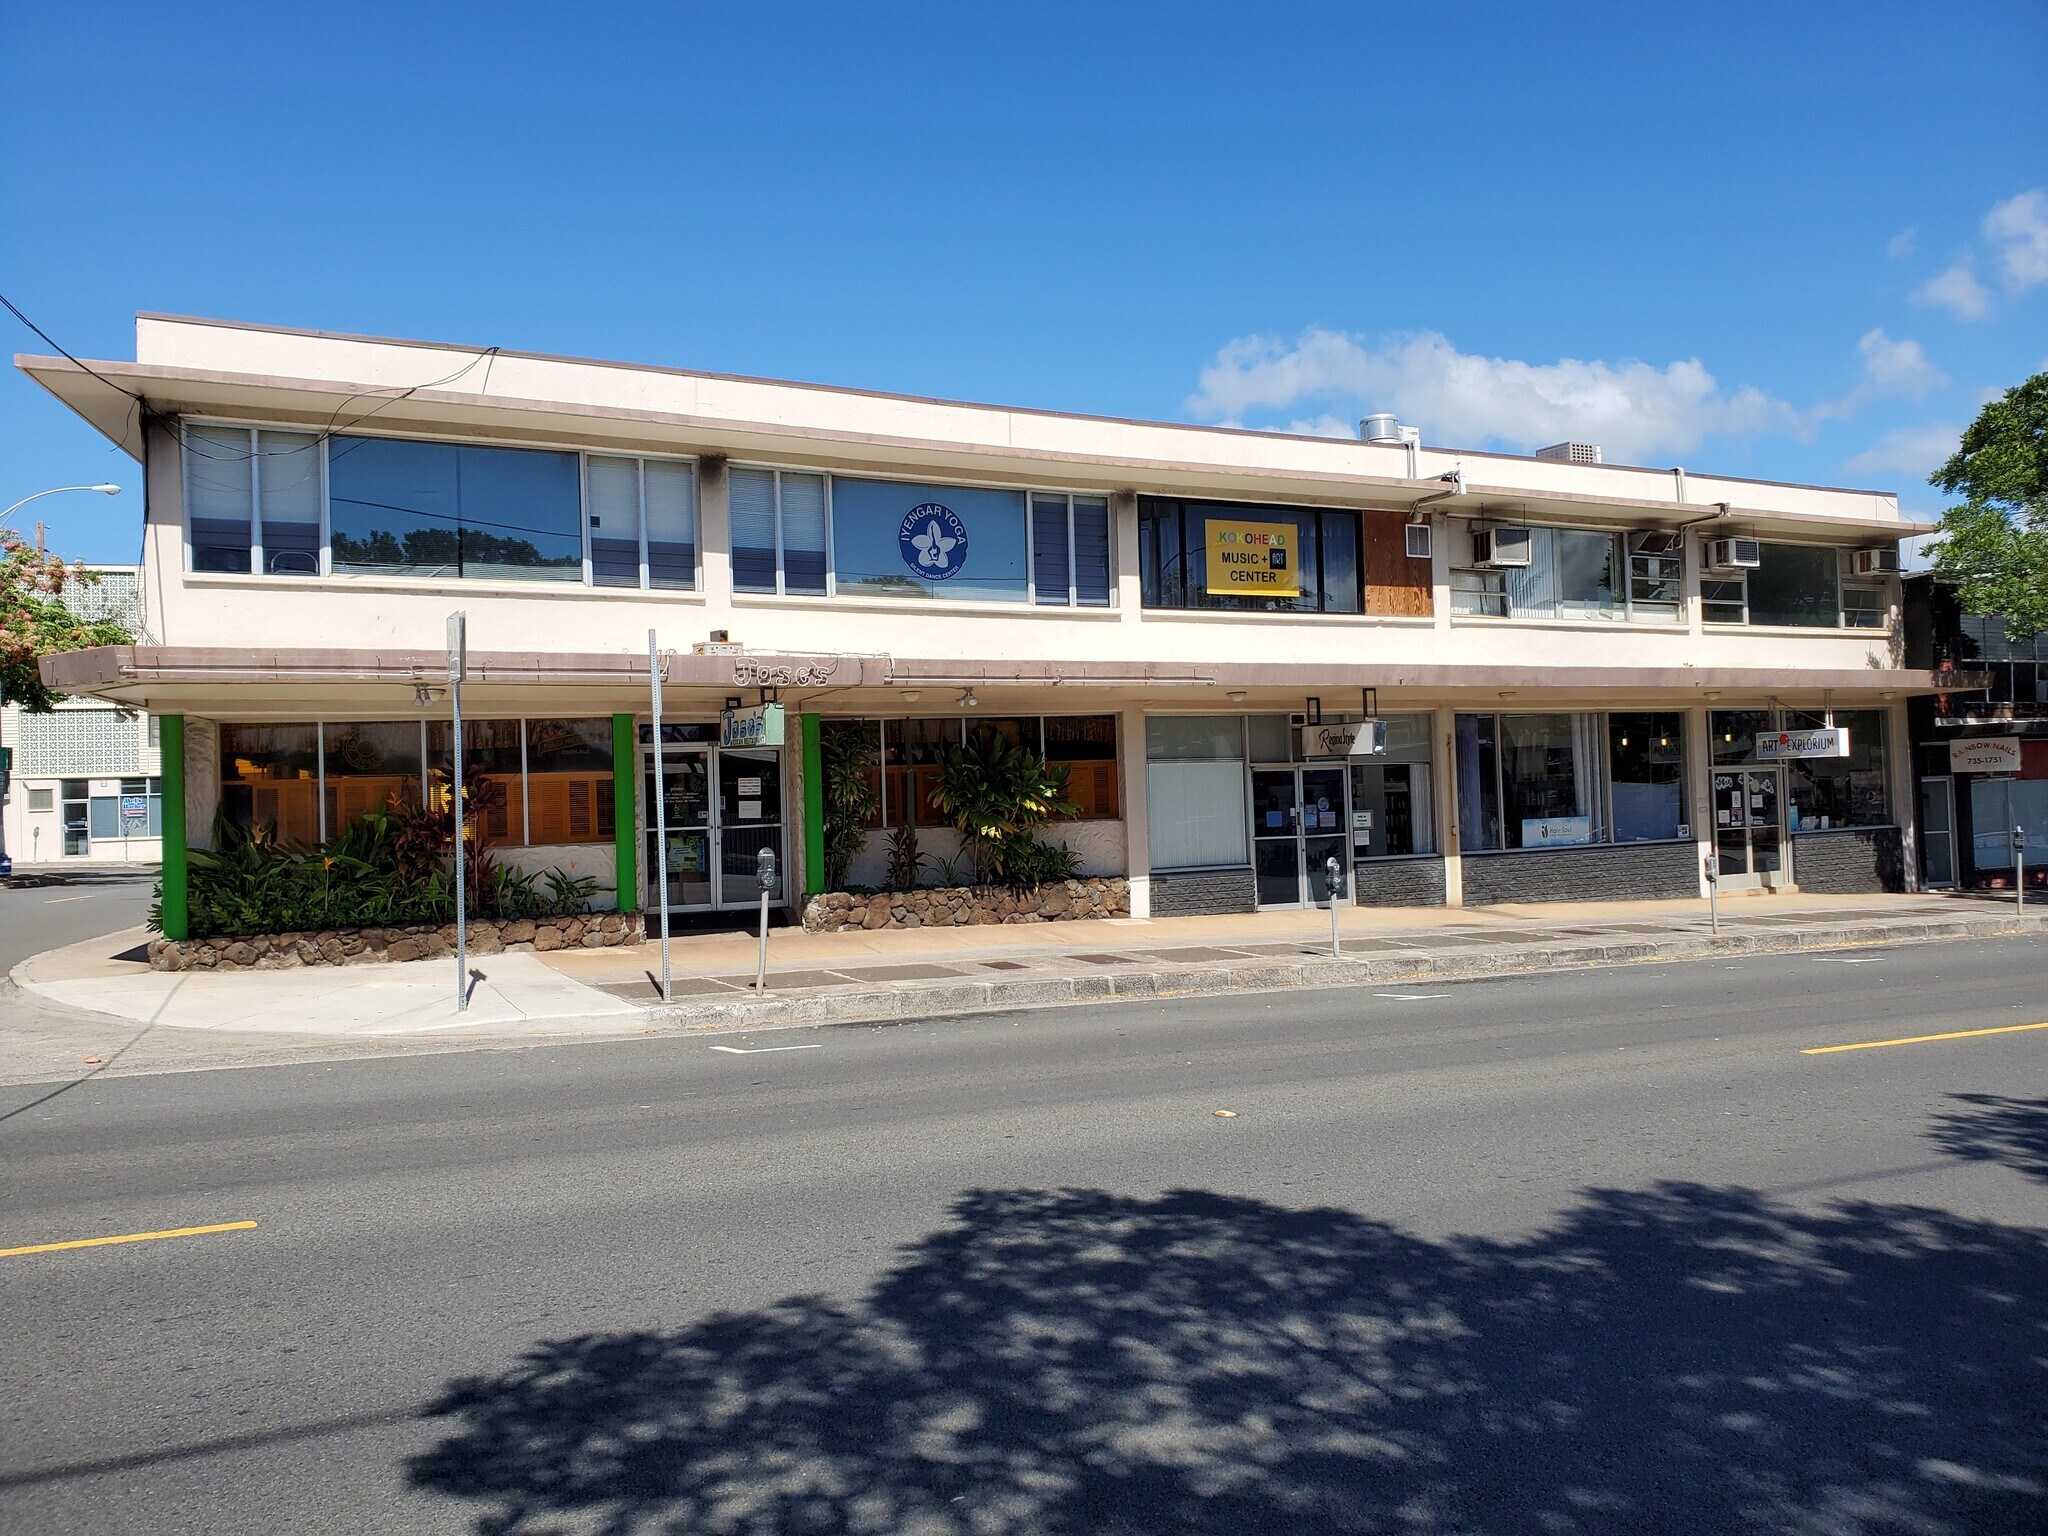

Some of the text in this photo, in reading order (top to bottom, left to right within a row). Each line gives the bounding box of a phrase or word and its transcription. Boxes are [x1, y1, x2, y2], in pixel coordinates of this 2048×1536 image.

[901, 505, 966, 545] IYENGAR YOGA
[1219, 531, 1286, 546] KOKOHEAD
[1221, 552, 1259, 565] MUSIC
[909, 563, 926, 577] SILENT
[943, 565, 960, 579] CENTER
[1230, 570, 1277, 583] CENTER
[1762, 737, 1835, 752] ART EXPLORIUM
[1952, 742, 2017, 759] RAINBOW NAILS
[1967, 756, 2002, 765] 735-1751
